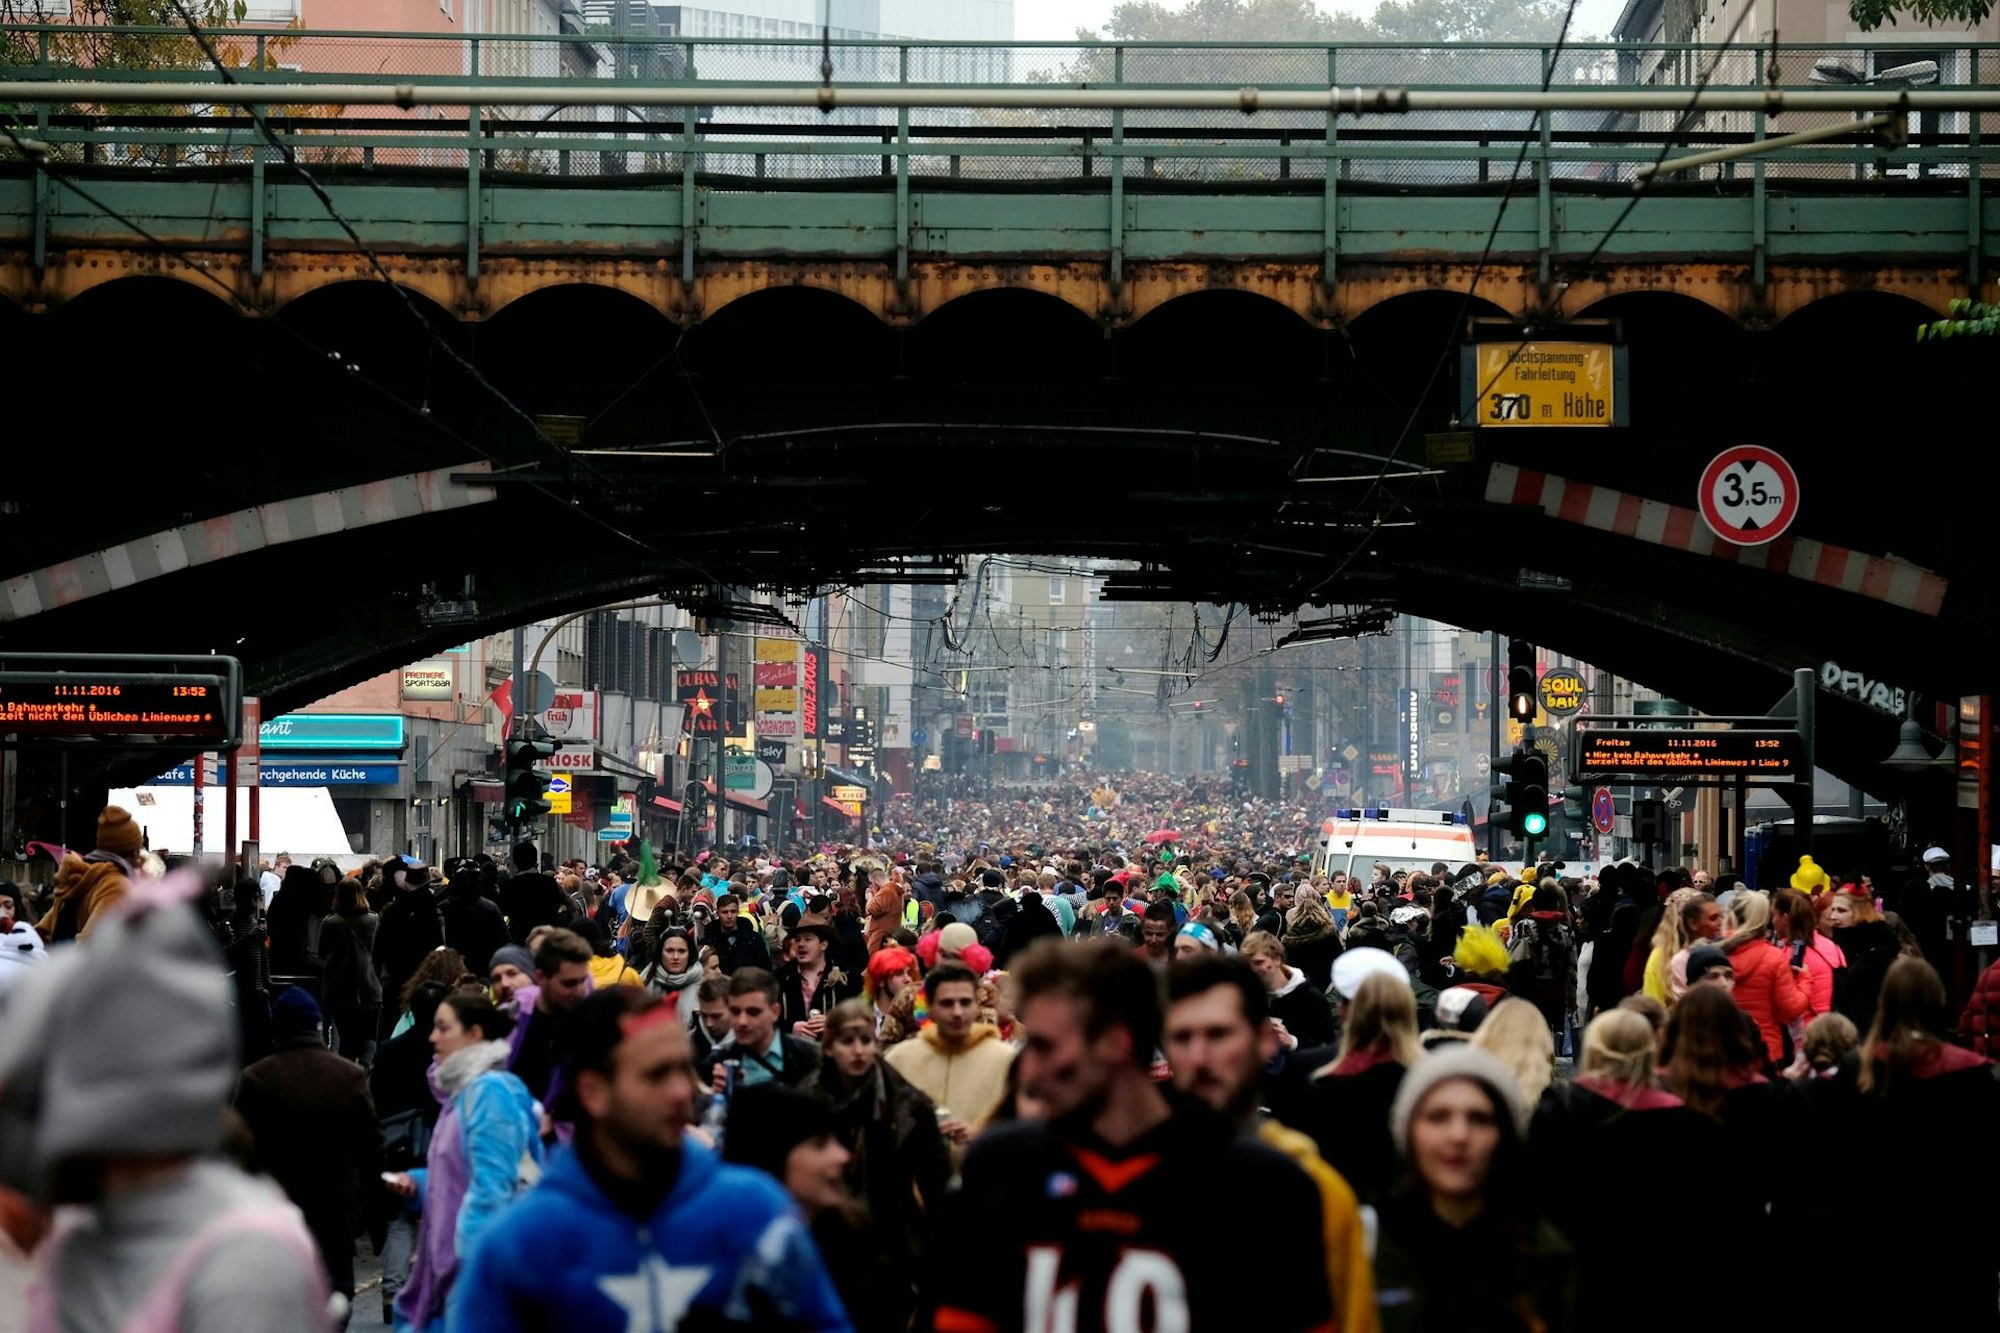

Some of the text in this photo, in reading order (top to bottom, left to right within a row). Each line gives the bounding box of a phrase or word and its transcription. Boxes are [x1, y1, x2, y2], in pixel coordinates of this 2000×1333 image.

[1508, 350, 1584, 366] Hochspannung
[1515, 367, 1576, 383] Fahrleitung
[1542, 404, 1552, 417] m
[1564, 391, 1605, 418] Höhe
[54, 685, 206, 697] 11.11.2016 13:52
[1541, 678, 1584, 693] SOUL
[804, 653, 817, 735] RENDEZVOUS
[7, 702, 84, 712] Bahnverkehr
[28, 711, 59, 721] nicht
[62, 711, 85, 721] den
[141, 711, 200, 722] Linienweg
[755, 715, 797, 735] Schawarma
[1596, 738, 1780, 748] Freitag 11.11.2016 13:52
[762, 745, 783, 759] sky
[1592, 751, 1690, 760] Hier kein Bahnverkehr
[545, 754, 591, 767] KIOSK
[1586, 758, 1619, 766] zurzeit
[1621, 758, 1645, 766] nicht
[1647, 758, 1664, 766] den
[1705, 759, 1748, 767] Linienweg
[1758, 759, 1780, 767] Linie
[331, 768, 366, 780] Küche
[842, 790, 865, 798] KIOSK
